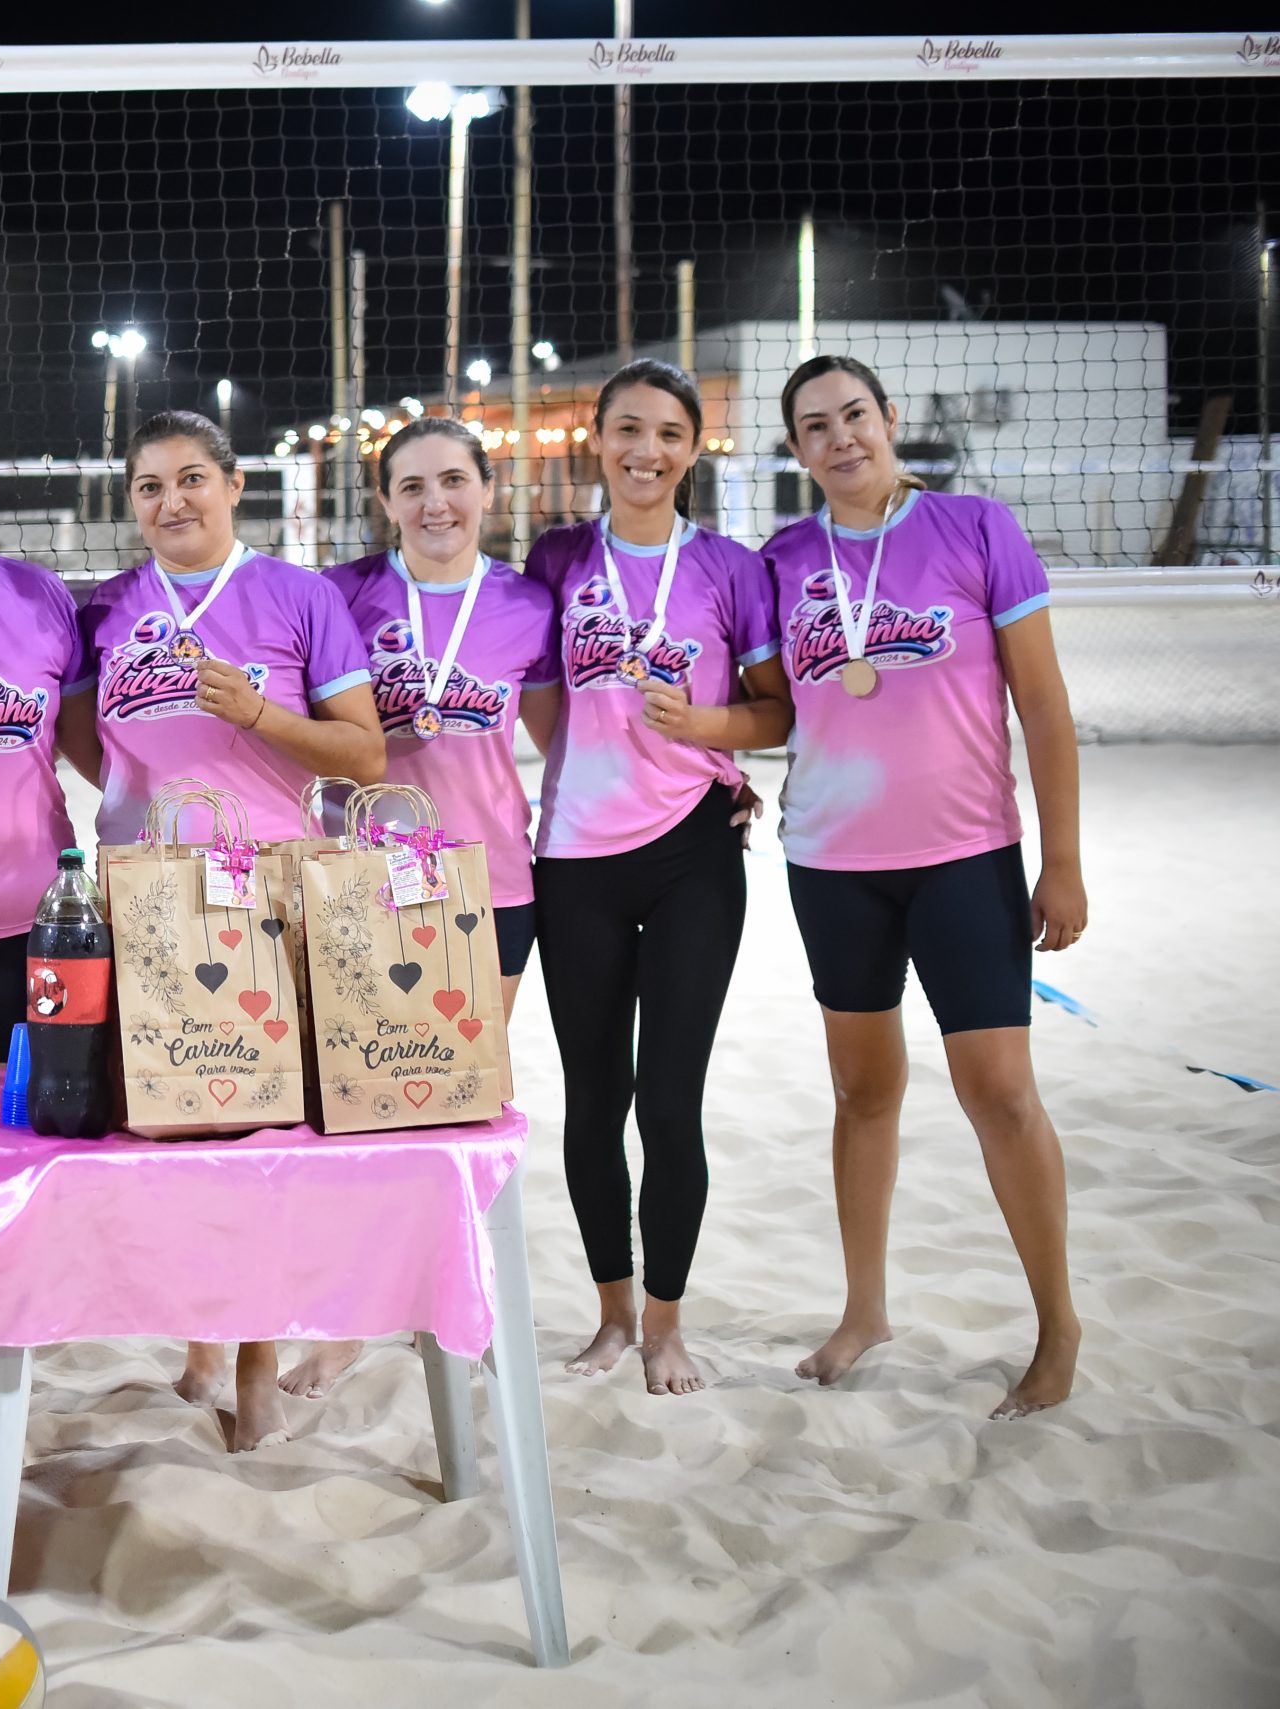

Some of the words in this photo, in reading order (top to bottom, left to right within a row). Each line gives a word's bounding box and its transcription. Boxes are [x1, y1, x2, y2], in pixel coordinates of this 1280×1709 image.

[282, 47, 342, 67] Bebella
[618, 43, 676, 63] Bebella
[944, 40, 1004, 60] Bebella
[872, 605, 891, 618] da
[132, 648, 176, 671] Clu
[872, 655, 899, 665] 2024
[154, 702, 179, 714] desde
[181, 1017, 213, 1035] Com
[376, 1018, 409, 1037] Com
[163, 1034, 260, 1067] Carinho
[358, 1034, 455, 1070] Carinho
[195, 1064, 226, 1078] Para
[390, 1066, 422, 1080] Para
